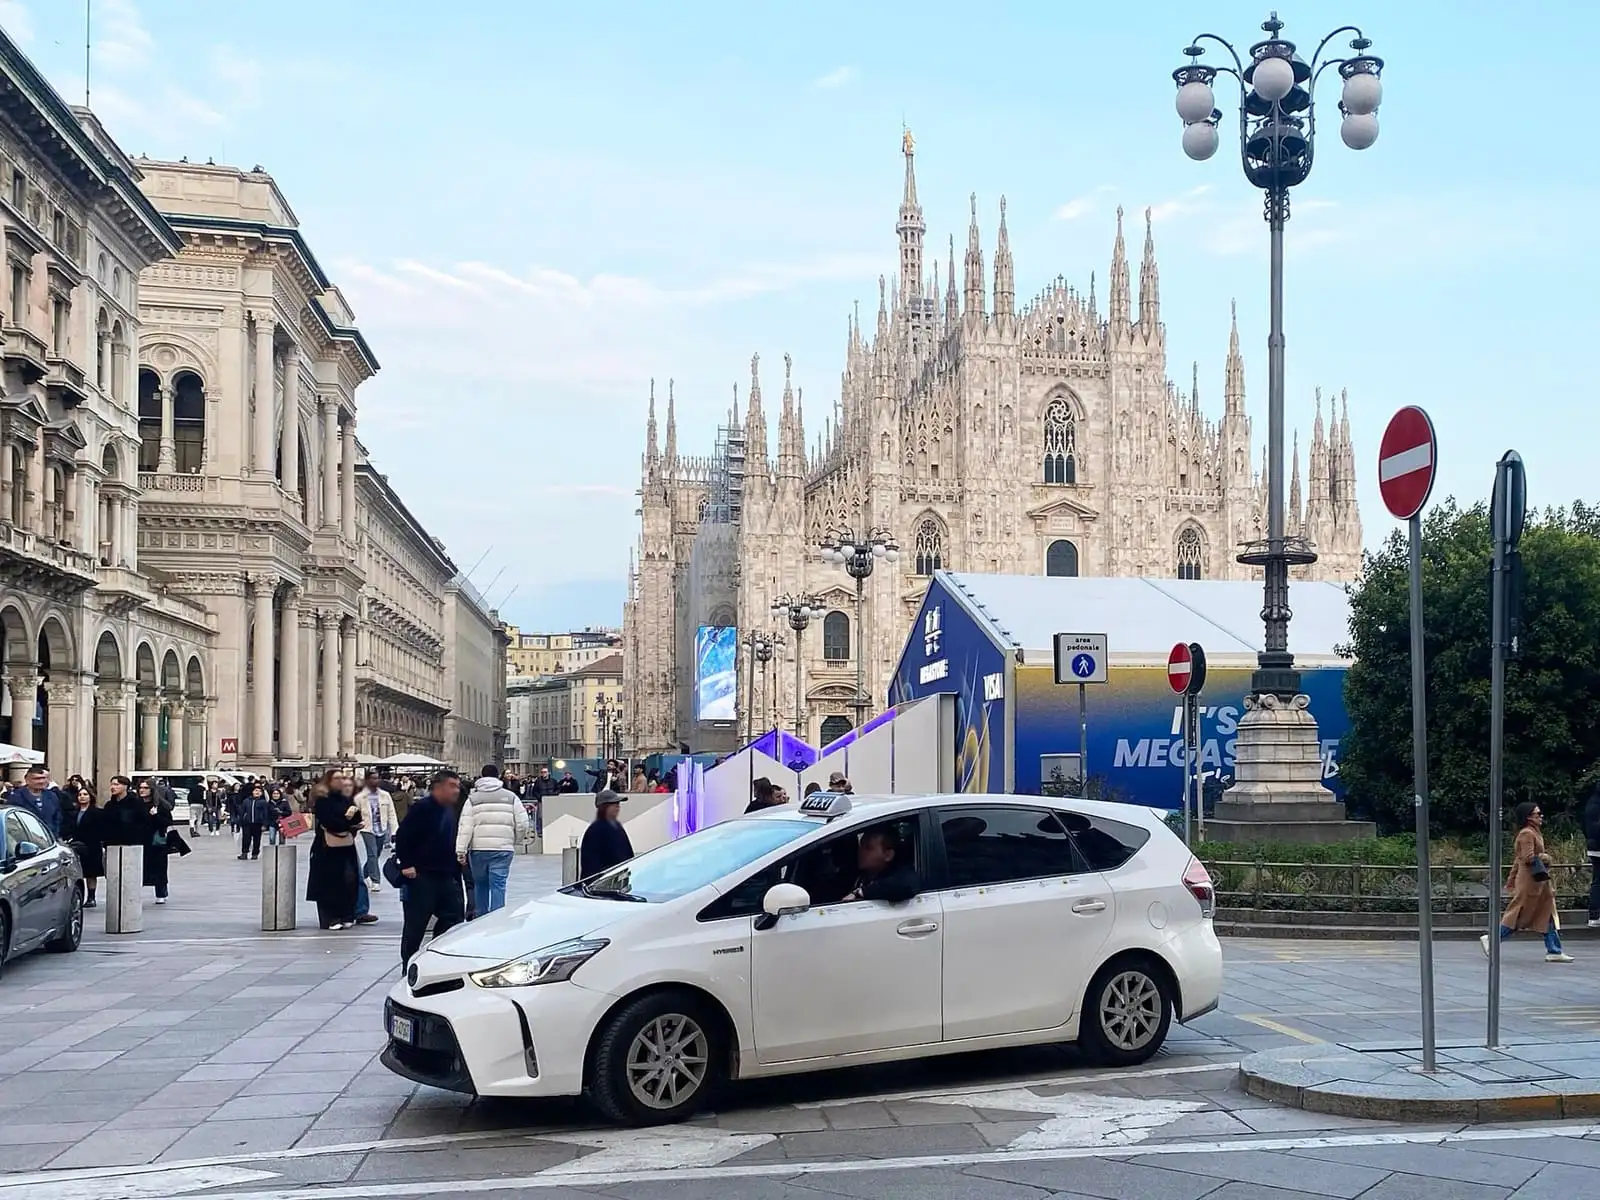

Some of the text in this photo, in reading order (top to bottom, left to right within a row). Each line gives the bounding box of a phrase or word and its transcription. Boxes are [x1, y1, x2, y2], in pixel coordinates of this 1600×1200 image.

[983, 673, 1004, 700] VISA
[1113, 738, 1340, 768] MEGASE
[803, 797, 835, 808] TAXI
